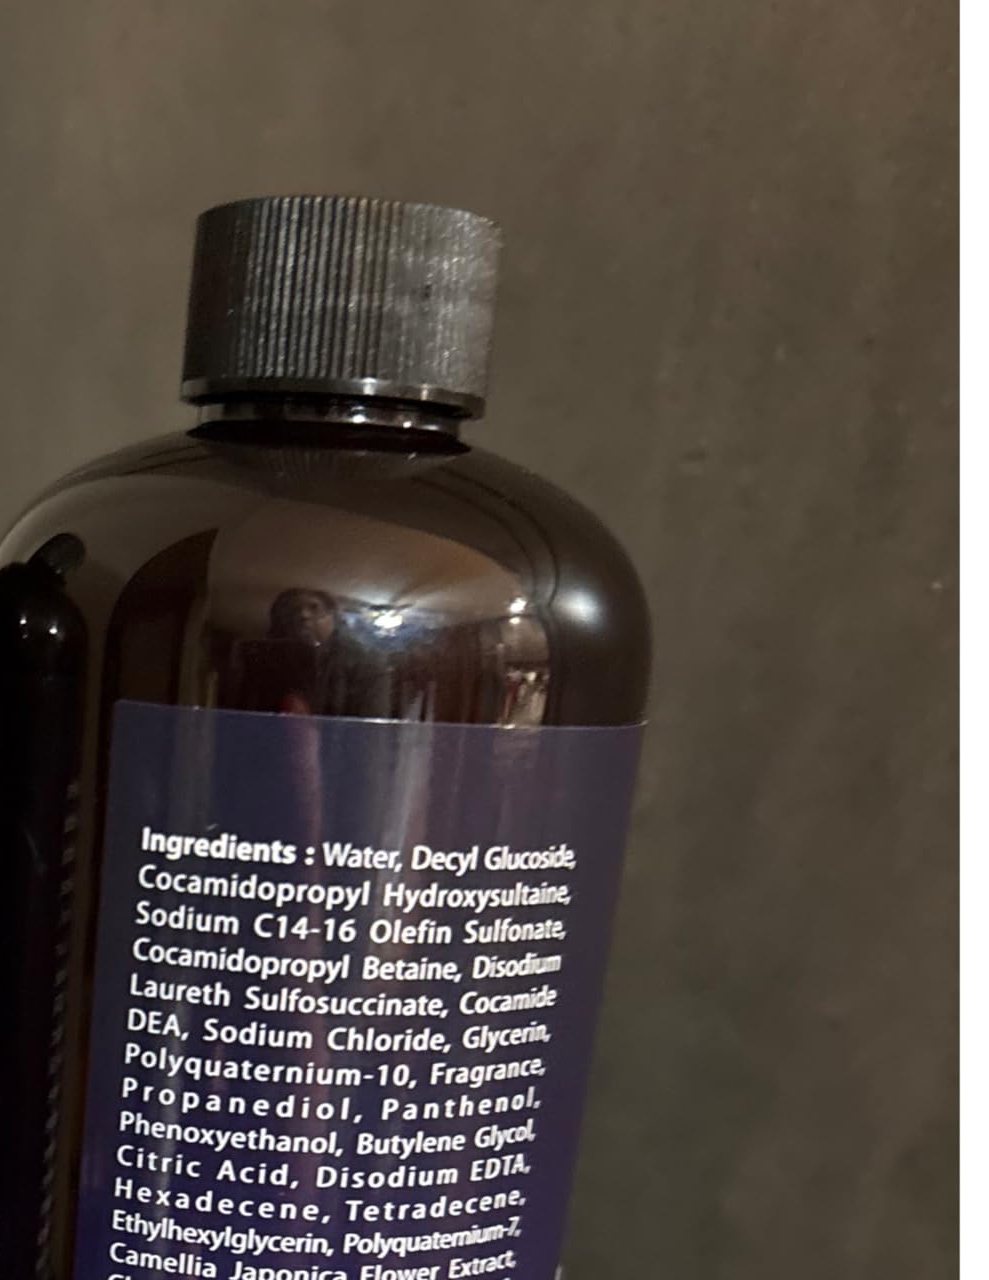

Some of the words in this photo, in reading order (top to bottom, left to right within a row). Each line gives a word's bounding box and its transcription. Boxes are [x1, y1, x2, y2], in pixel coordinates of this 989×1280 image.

[142, 826, 297, 864] Ingredients
[322, 842, 403, 873] Water,
[411, 845, 479, 877] Decyl
[139, 864, 371, 912] Cocamidopropyl
[135, 900, 239, 935] Sodium
[254, 913, 357, 942] C14-16
[369, 919, 452, 944] Olefin
[133, 937, 350, 984] Cocamidopropyl
[362, 955, 462, 983] Betaine,
[130, 973, 231, 1007] Laureth
[244, 986, 449, 1018] Sulfosuccinate,
[128, 1008, 189, 1041] DEA,
[203, 1018, 313, 1049] Sodium
[327, 1027, 451, 1053] Chloride,
[125, 1043, 417, 1089] Polyquaternium-10,
[122, 1077, 362, 1124] Propanediol,
[381, 1086, 541, 1120] Panthenol,
[120, 1111, 343, 1157] Phenoxyethanol,
[356, 1131, 466, 1160] Butylene
[117, 1145, 201, 1178] Citric
[216, 1160, 299, 1189] Acid,
[316, 1165, 458, 1188] Disodium
[470, 1153, 531, 1182] EDTA,
[115, 1177, 331, 1224] Hexadecene,
[345, 1190, 526, 1222] Tetradecene,
[112, 1209, 334, 1257] Ethylhexylglycerin,
[110, 1242, 217, 1278] Camellia
